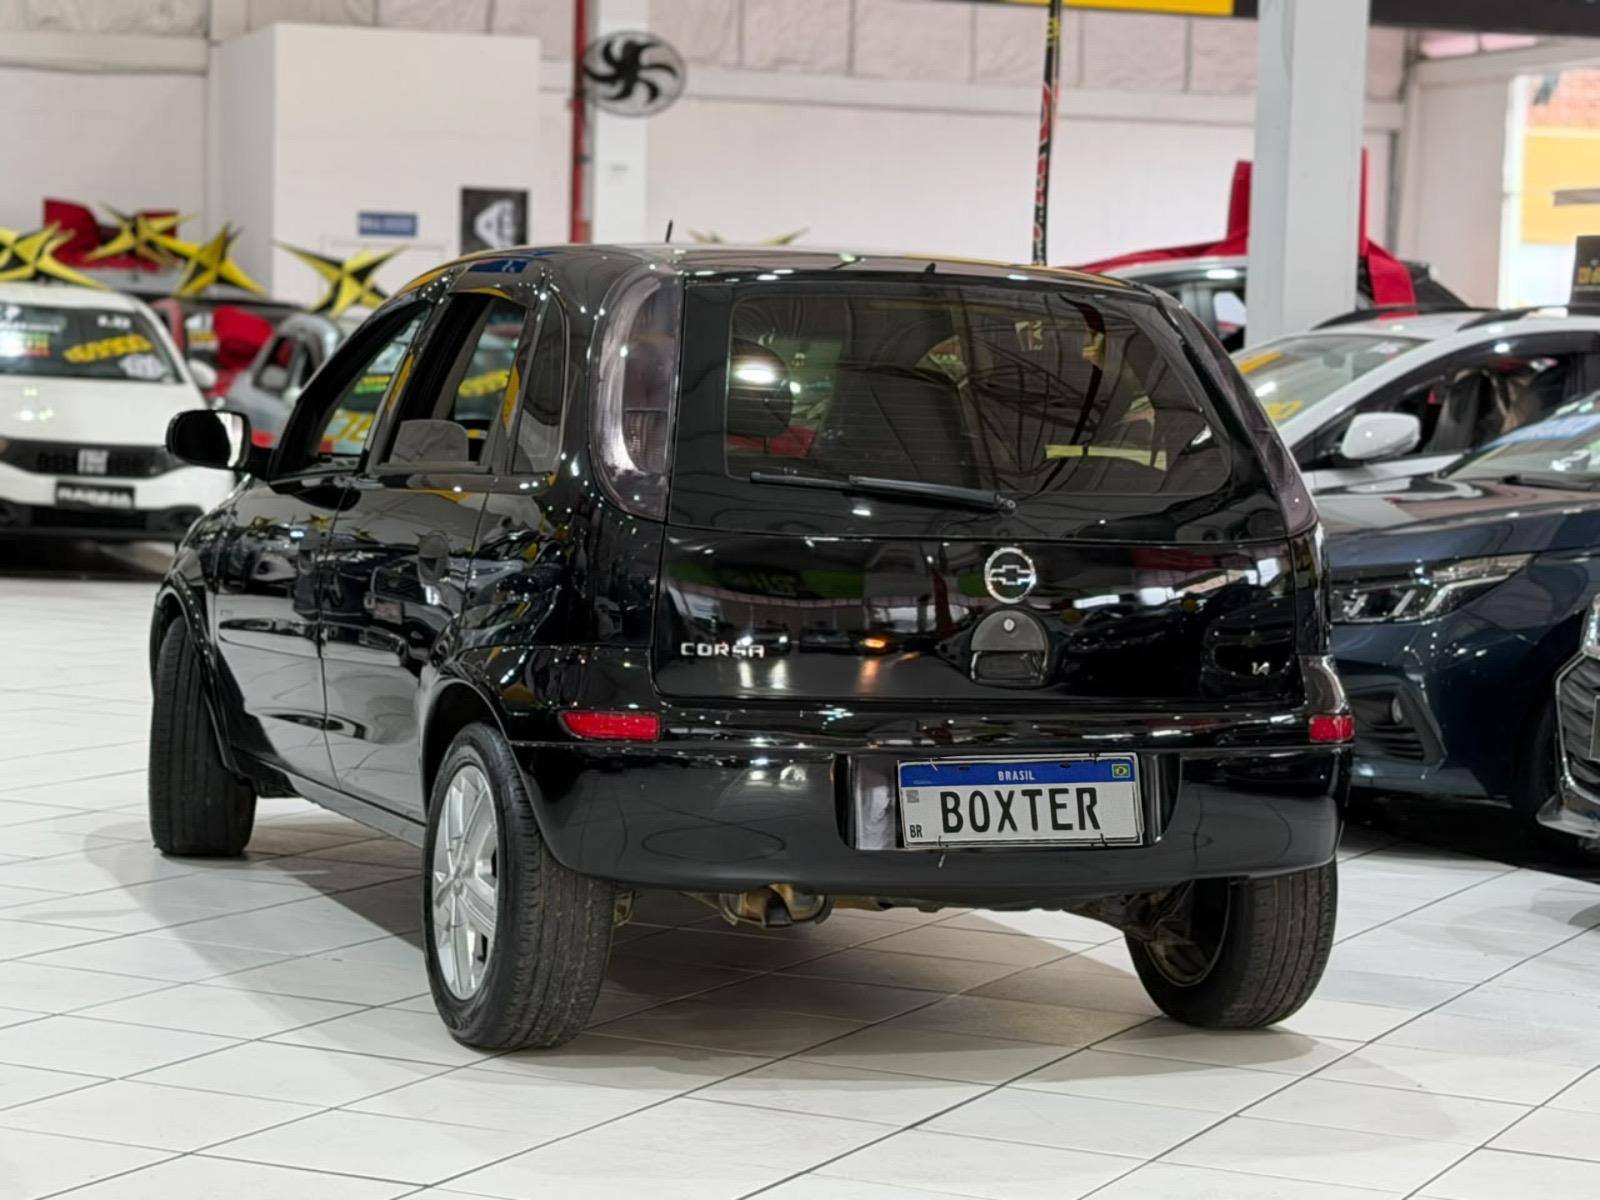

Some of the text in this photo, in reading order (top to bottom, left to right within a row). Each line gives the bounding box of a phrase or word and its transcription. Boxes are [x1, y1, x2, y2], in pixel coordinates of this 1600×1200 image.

[681, 642, 764, 659] CORSA
[998, 770, 1035, 781] BRASIL
[940, 787, 1100, 833] BOXTER
[909, 824, 923, 838] BR
